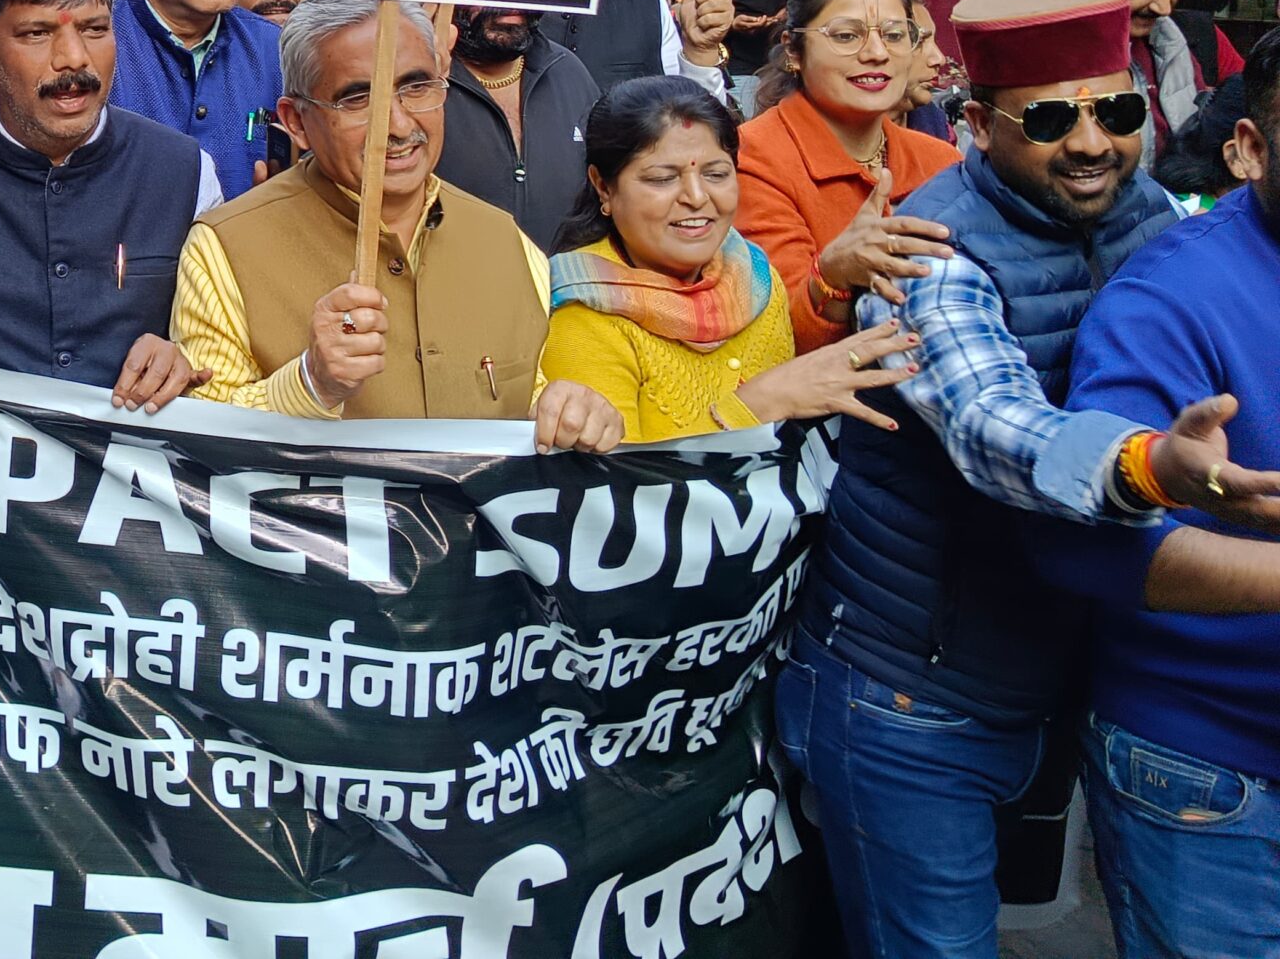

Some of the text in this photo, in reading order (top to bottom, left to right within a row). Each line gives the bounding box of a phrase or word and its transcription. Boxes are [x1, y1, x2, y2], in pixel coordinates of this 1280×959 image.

[220, 618, 487, 719] शर्मनाक
[73, 711, 194, 811] नारे
[204, 737, 457, 832] लगाकर
[464, 737, 540, 825] देश
